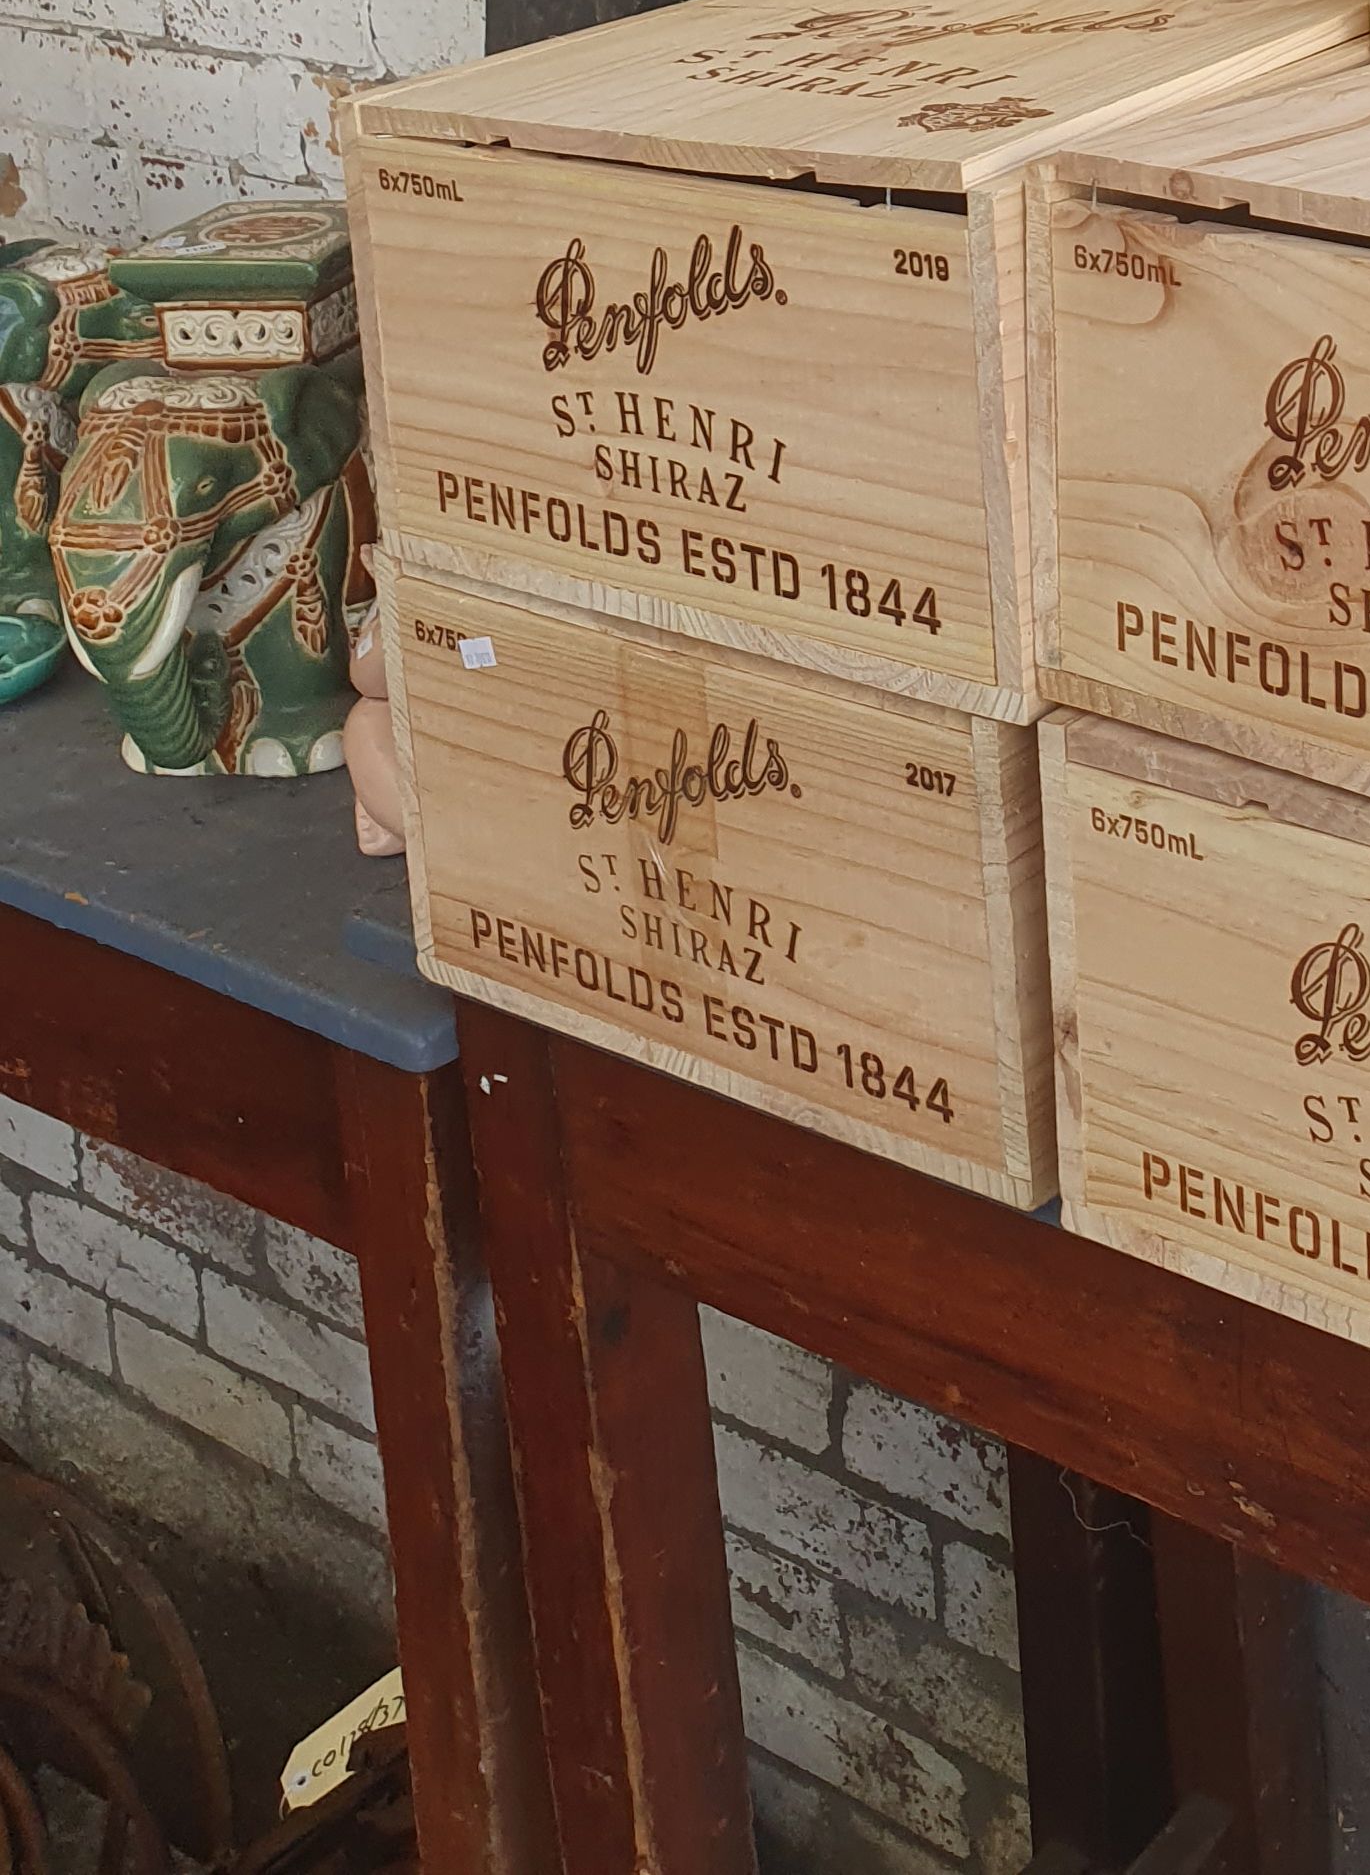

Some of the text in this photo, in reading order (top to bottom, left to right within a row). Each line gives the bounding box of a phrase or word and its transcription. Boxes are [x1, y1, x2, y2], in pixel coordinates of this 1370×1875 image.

[684, 65, 917, 100] SHIRAZ
[780, 50, 1019, 90] HENRI
[377, 167, 464, 203] 6x750mL
[1073, 244, 1182, 289] 6x750mL
[613, 391, 788, 484] HENRI
[595, 443, 748, 513] SHIRAZ
[436, 470, 943, 637] PENFOLDS ESTD 1844
[906, 762, 957, 798] 2017
[1091, 808, 1204, 862] 6x750mL
[637, 857, 803, 964] HENRI
[621, 902, 765, 986] SHIRAZ
[469, 908, 956, 1125] PENFOLDS ESTD 1844
